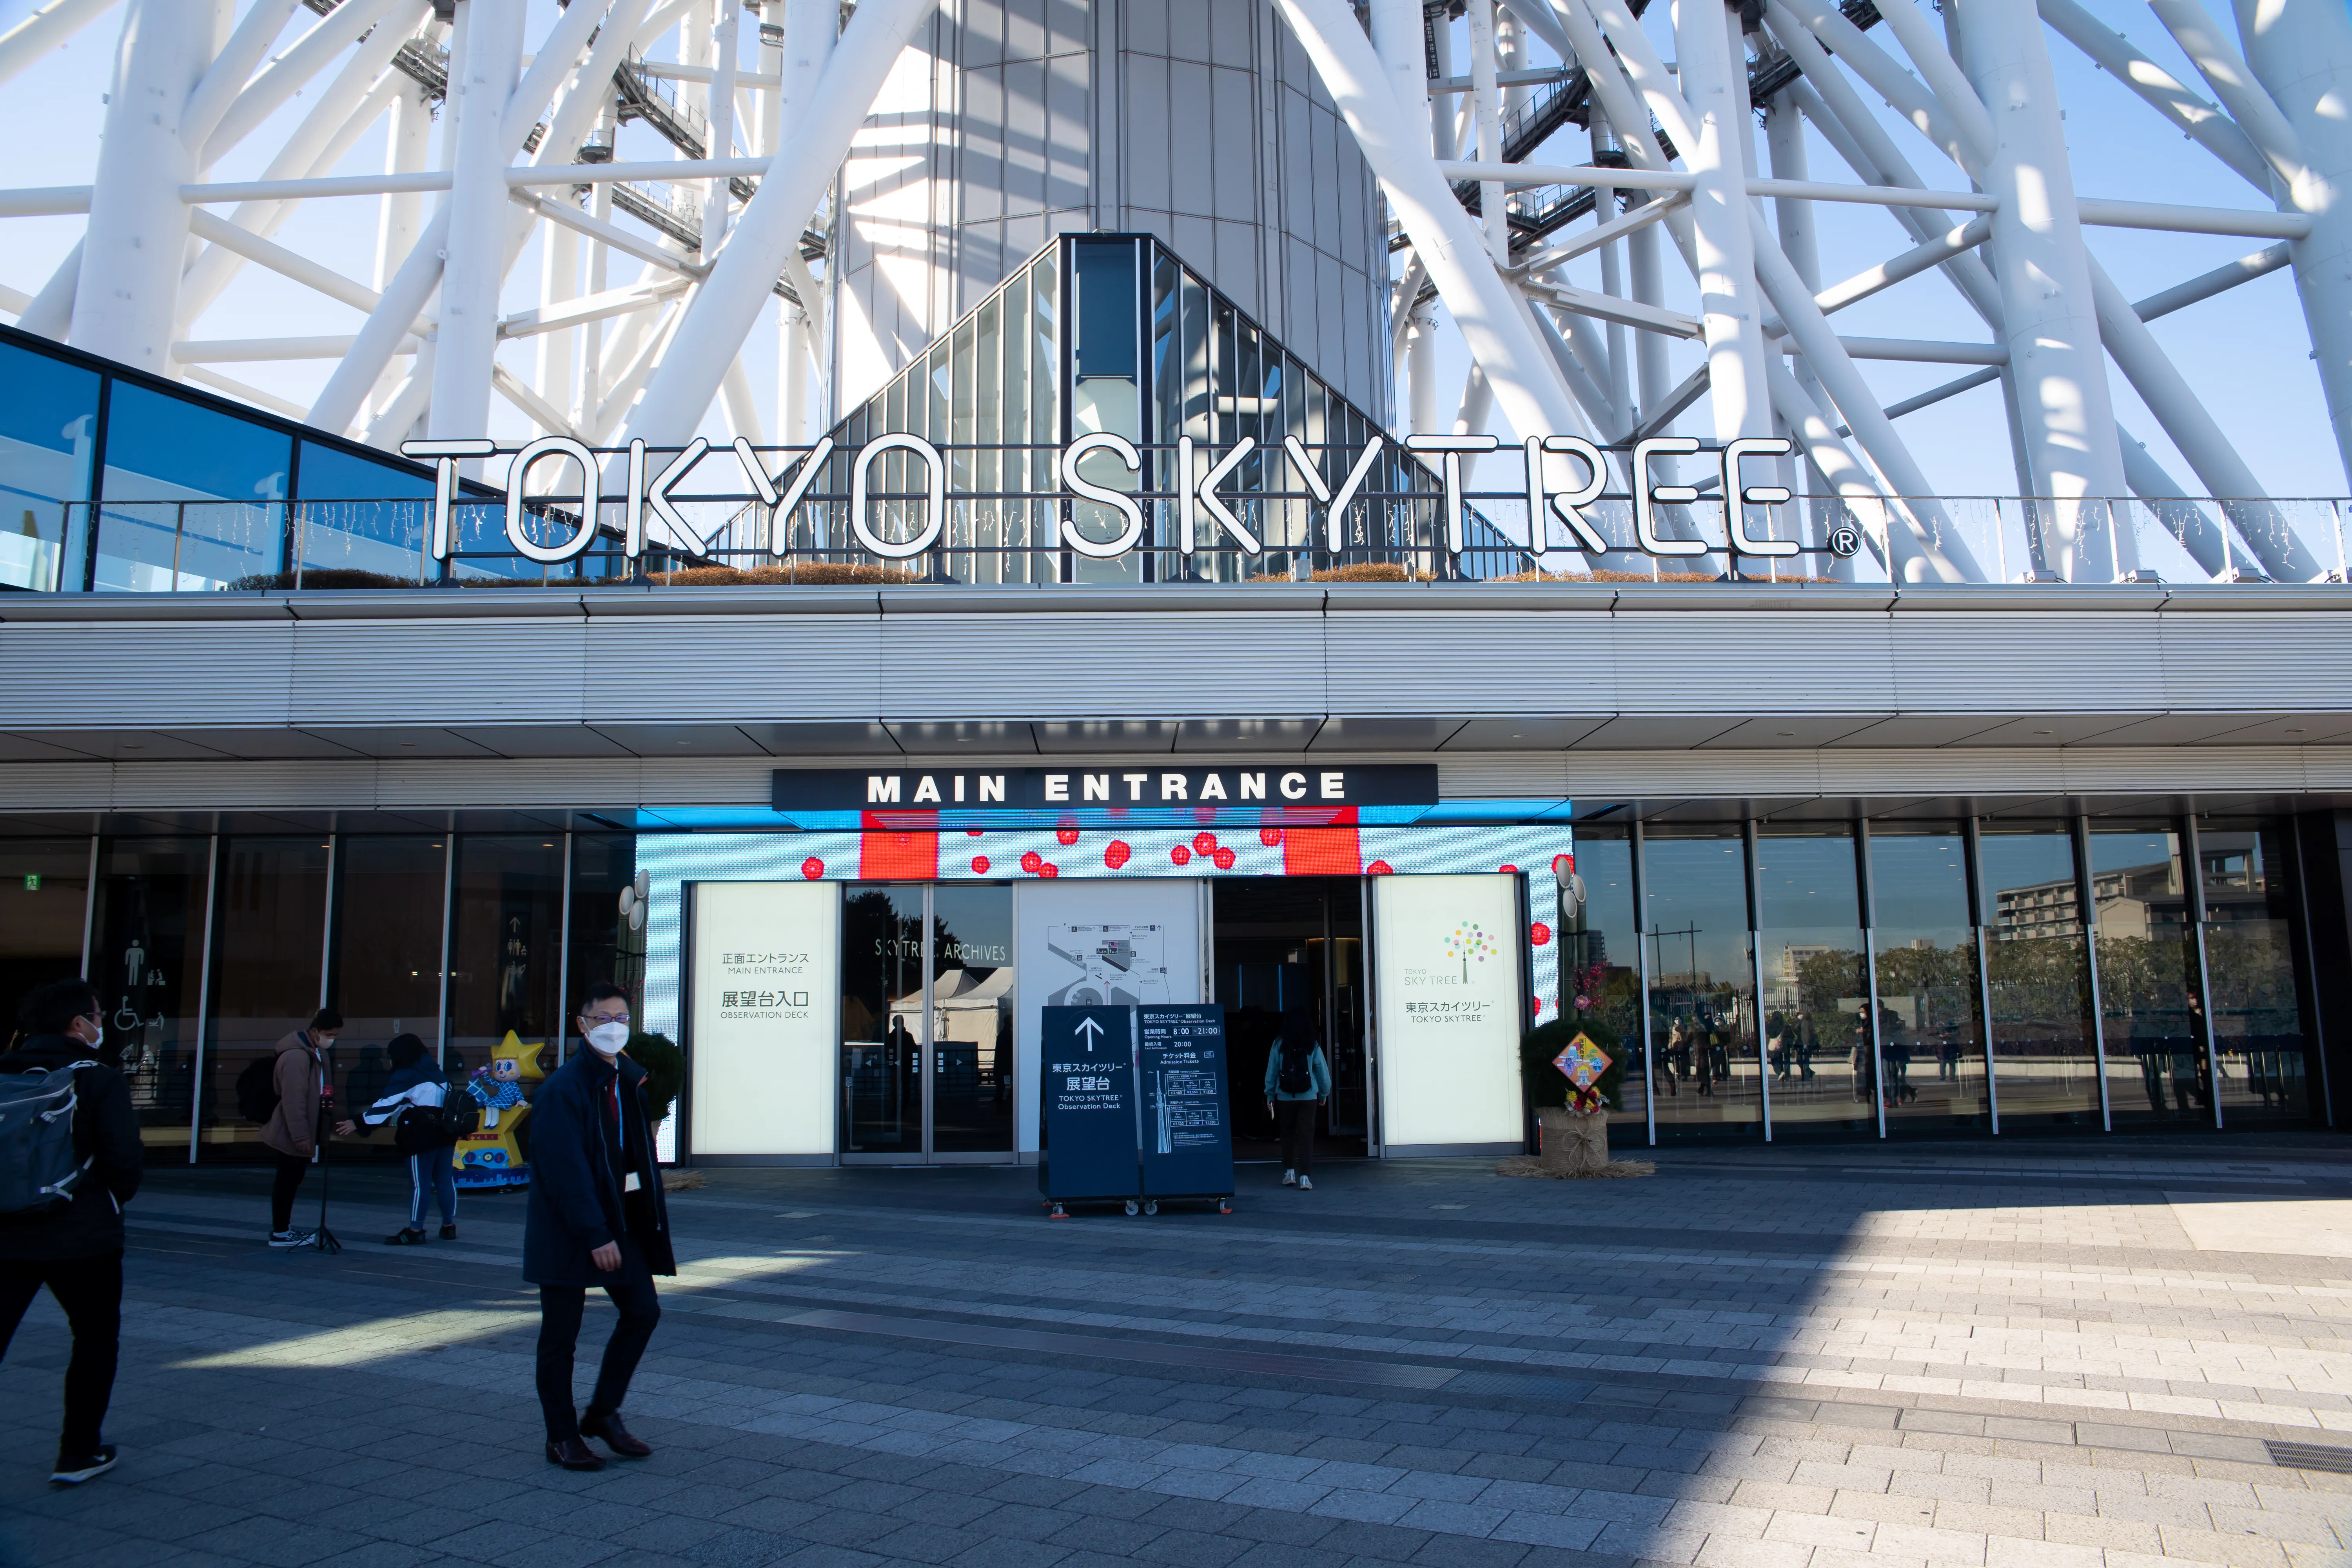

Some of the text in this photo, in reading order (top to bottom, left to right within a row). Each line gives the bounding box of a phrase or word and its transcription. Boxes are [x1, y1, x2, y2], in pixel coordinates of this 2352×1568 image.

[400, 432, 944, 563] TOKYO
[867, 772, 1345, 802] MAIN ENTRANCE
[722, 953, 809, 964] 正面エントランス
[945, 943, 1005, 961] ARCHIVES
[722, 991, 808, 1007] 展望台入口
[1066, 1076, 1110, 1091] 展望台
